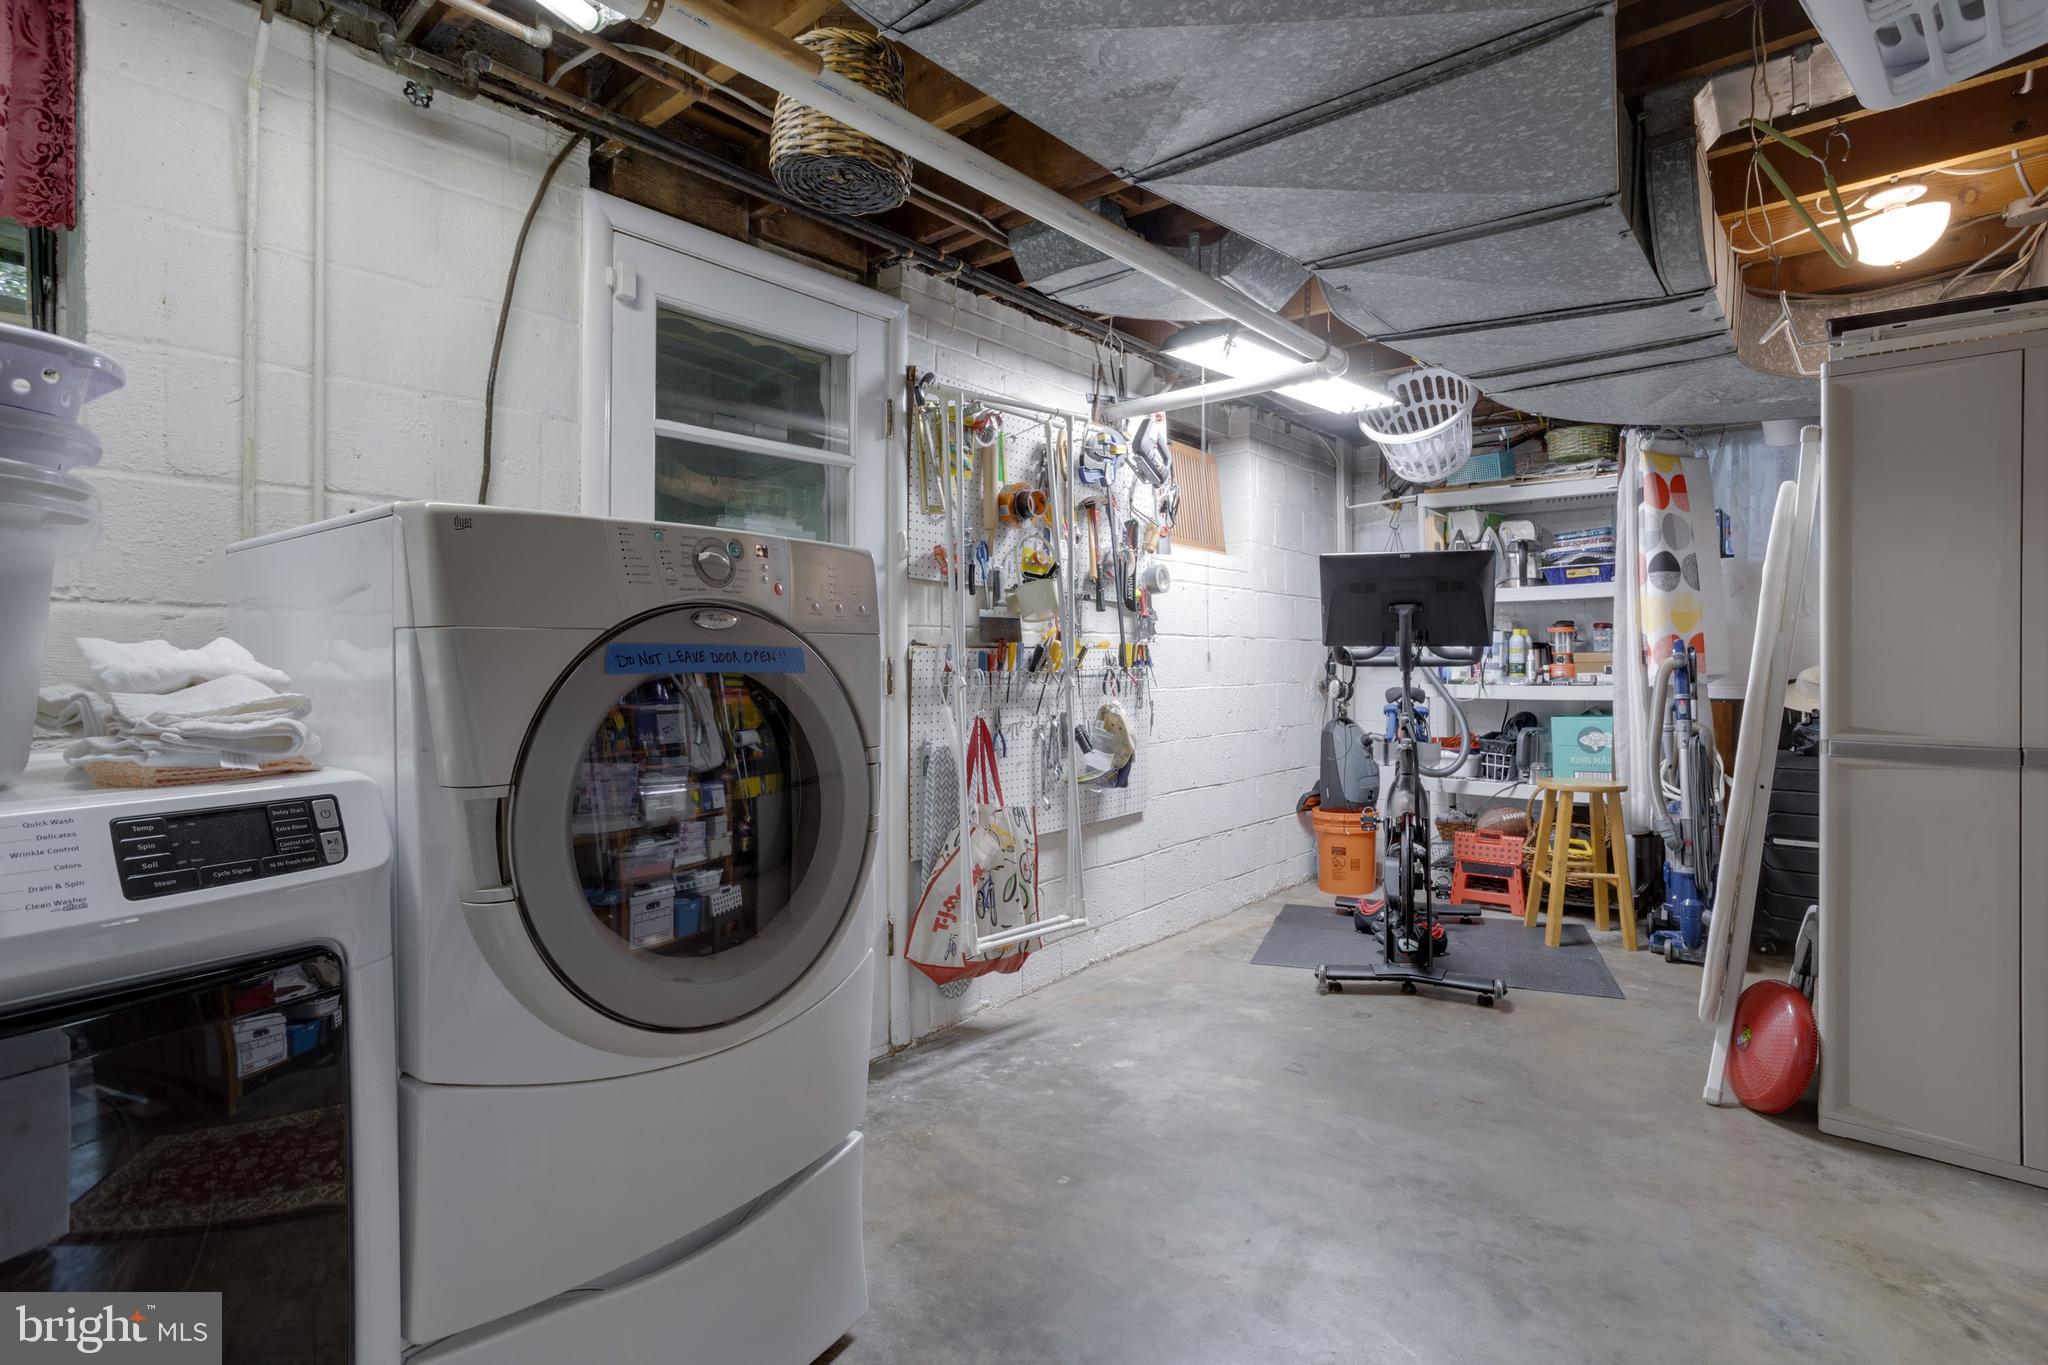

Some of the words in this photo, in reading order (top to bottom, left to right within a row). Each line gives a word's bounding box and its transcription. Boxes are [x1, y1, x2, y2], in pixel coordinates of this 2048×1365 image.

[615, 654, 635, 669] DO
[638, 651, 662, 667] NOT
[667, 650, 705, 664] LEAVE
[710, 651, 742, 664] DOOR
[22, 820, 48, 829] Quick
[49, 817, 75, 825] Wash
[131, 824, 154, 833] Temp
[36, 831, 77, 841] Delicates
[137, 843, 156, 851] Spin
[279, 839, 301, 848] Control
[9, 849, 45, 859] Wrinkle
[47, 845, 80, 855] Control
[54, 862, 82, 871] Colors
[141, 861, 158, 870] Soil
[285, 858, 301, 866] Fresh
[213, 870, 231, 878] Cycle
[231, 866, 252, 875] Signal
[28, 884, 53, 894] Drain
[64, 880, 85, 889] Spin
[153, 879, 177, 888] Steam
[25, 902, 51, 911] Clean
[53, 896, 87, 907] Washer
